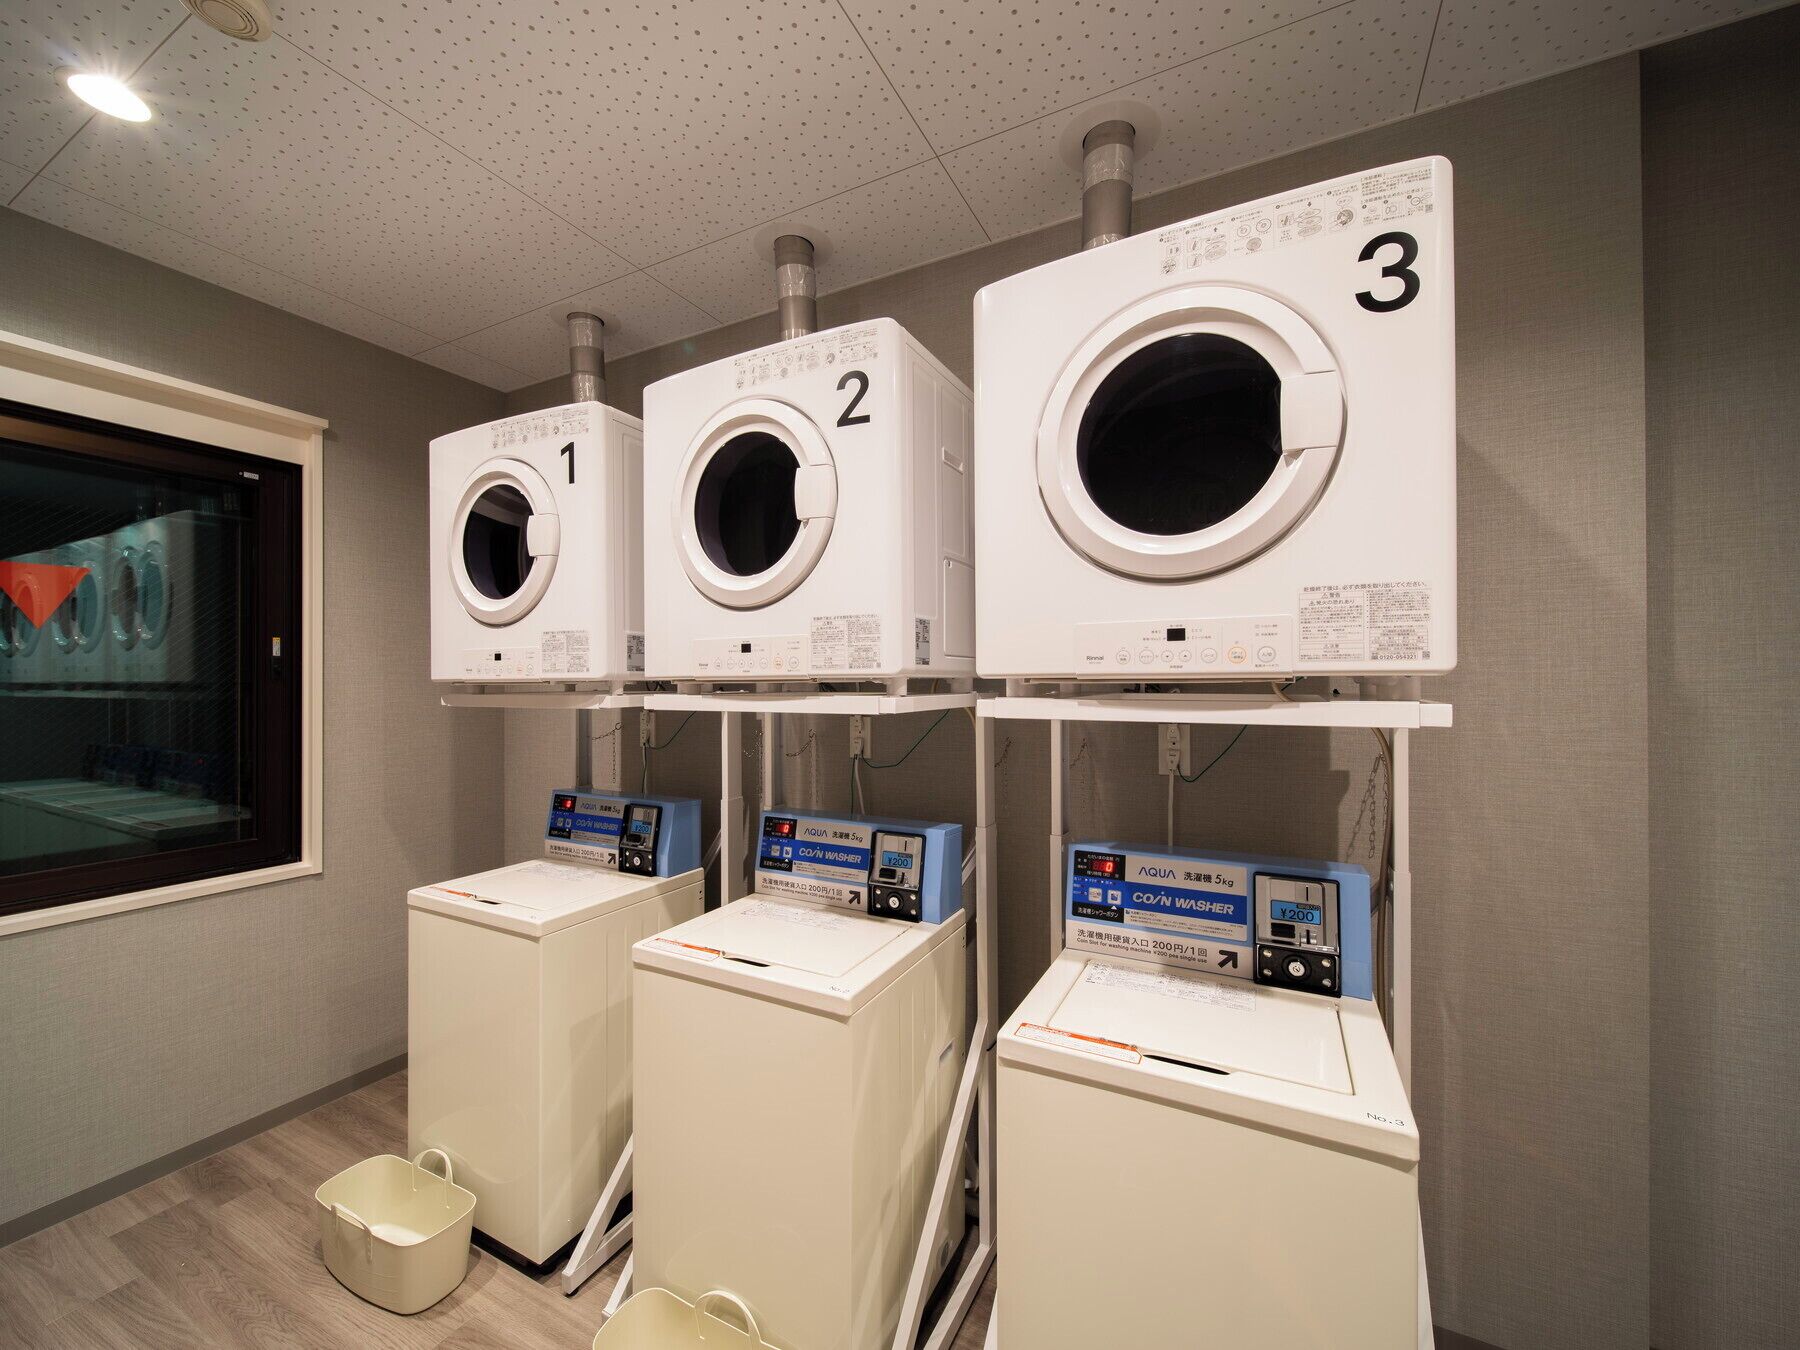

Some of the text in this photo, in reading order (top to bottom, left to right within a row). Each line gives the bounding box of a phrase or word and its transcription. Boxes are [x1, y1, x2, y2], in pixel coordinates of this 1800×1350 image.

[1355, 231, 1420, 313] 3
[836, 370, 871, 428] 2
[560, 441, 575, 484] 1
[803, 828, 864, 843] AQUA 洗濯機 5kg
[825, 851, 862, 864] WASHER
[887, 856, 909, 867] ¥200
[1105, 862, 1113, 873] 0
[1138, 866, 1234, 888] AQUA 洗濯機 5kg
[808, 884, 843, 897] 200円/1回
[1175, 897, 1234, 915] WASHER
[1280, 908, 1315, 922] ¥200
[1077, 928, 1208, 957] 洗濯機用硬貨入口 200円/1回
[1108, 943, 1129, 952] washing
[1130, 946, 1152, 954] machine
[1179, 954, 1197, 962] single
[1366, 1112, 1405, 1127] No.3
